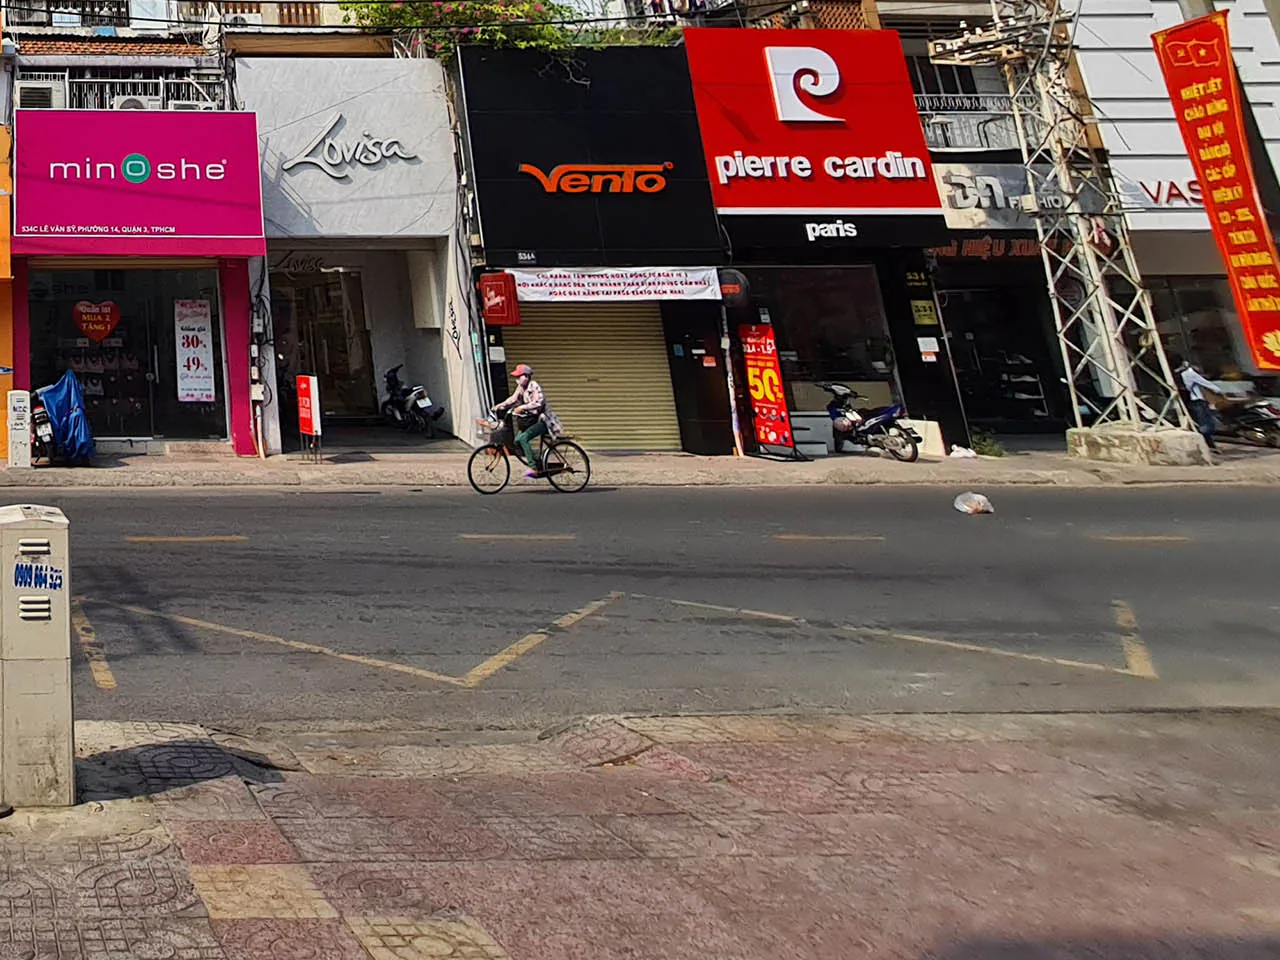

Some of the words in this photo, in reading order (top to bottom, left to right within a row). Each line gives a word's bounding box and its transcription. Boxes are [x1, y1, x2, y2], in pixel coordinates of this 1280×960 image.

[282, 111, 418, 178] Lovisa
[715, 151, 813, 184] pierre
[824, 151, 927, 179] cardin
[151, 226, 176, 234] TPHCM
[805, 220, 858, 241] paris
